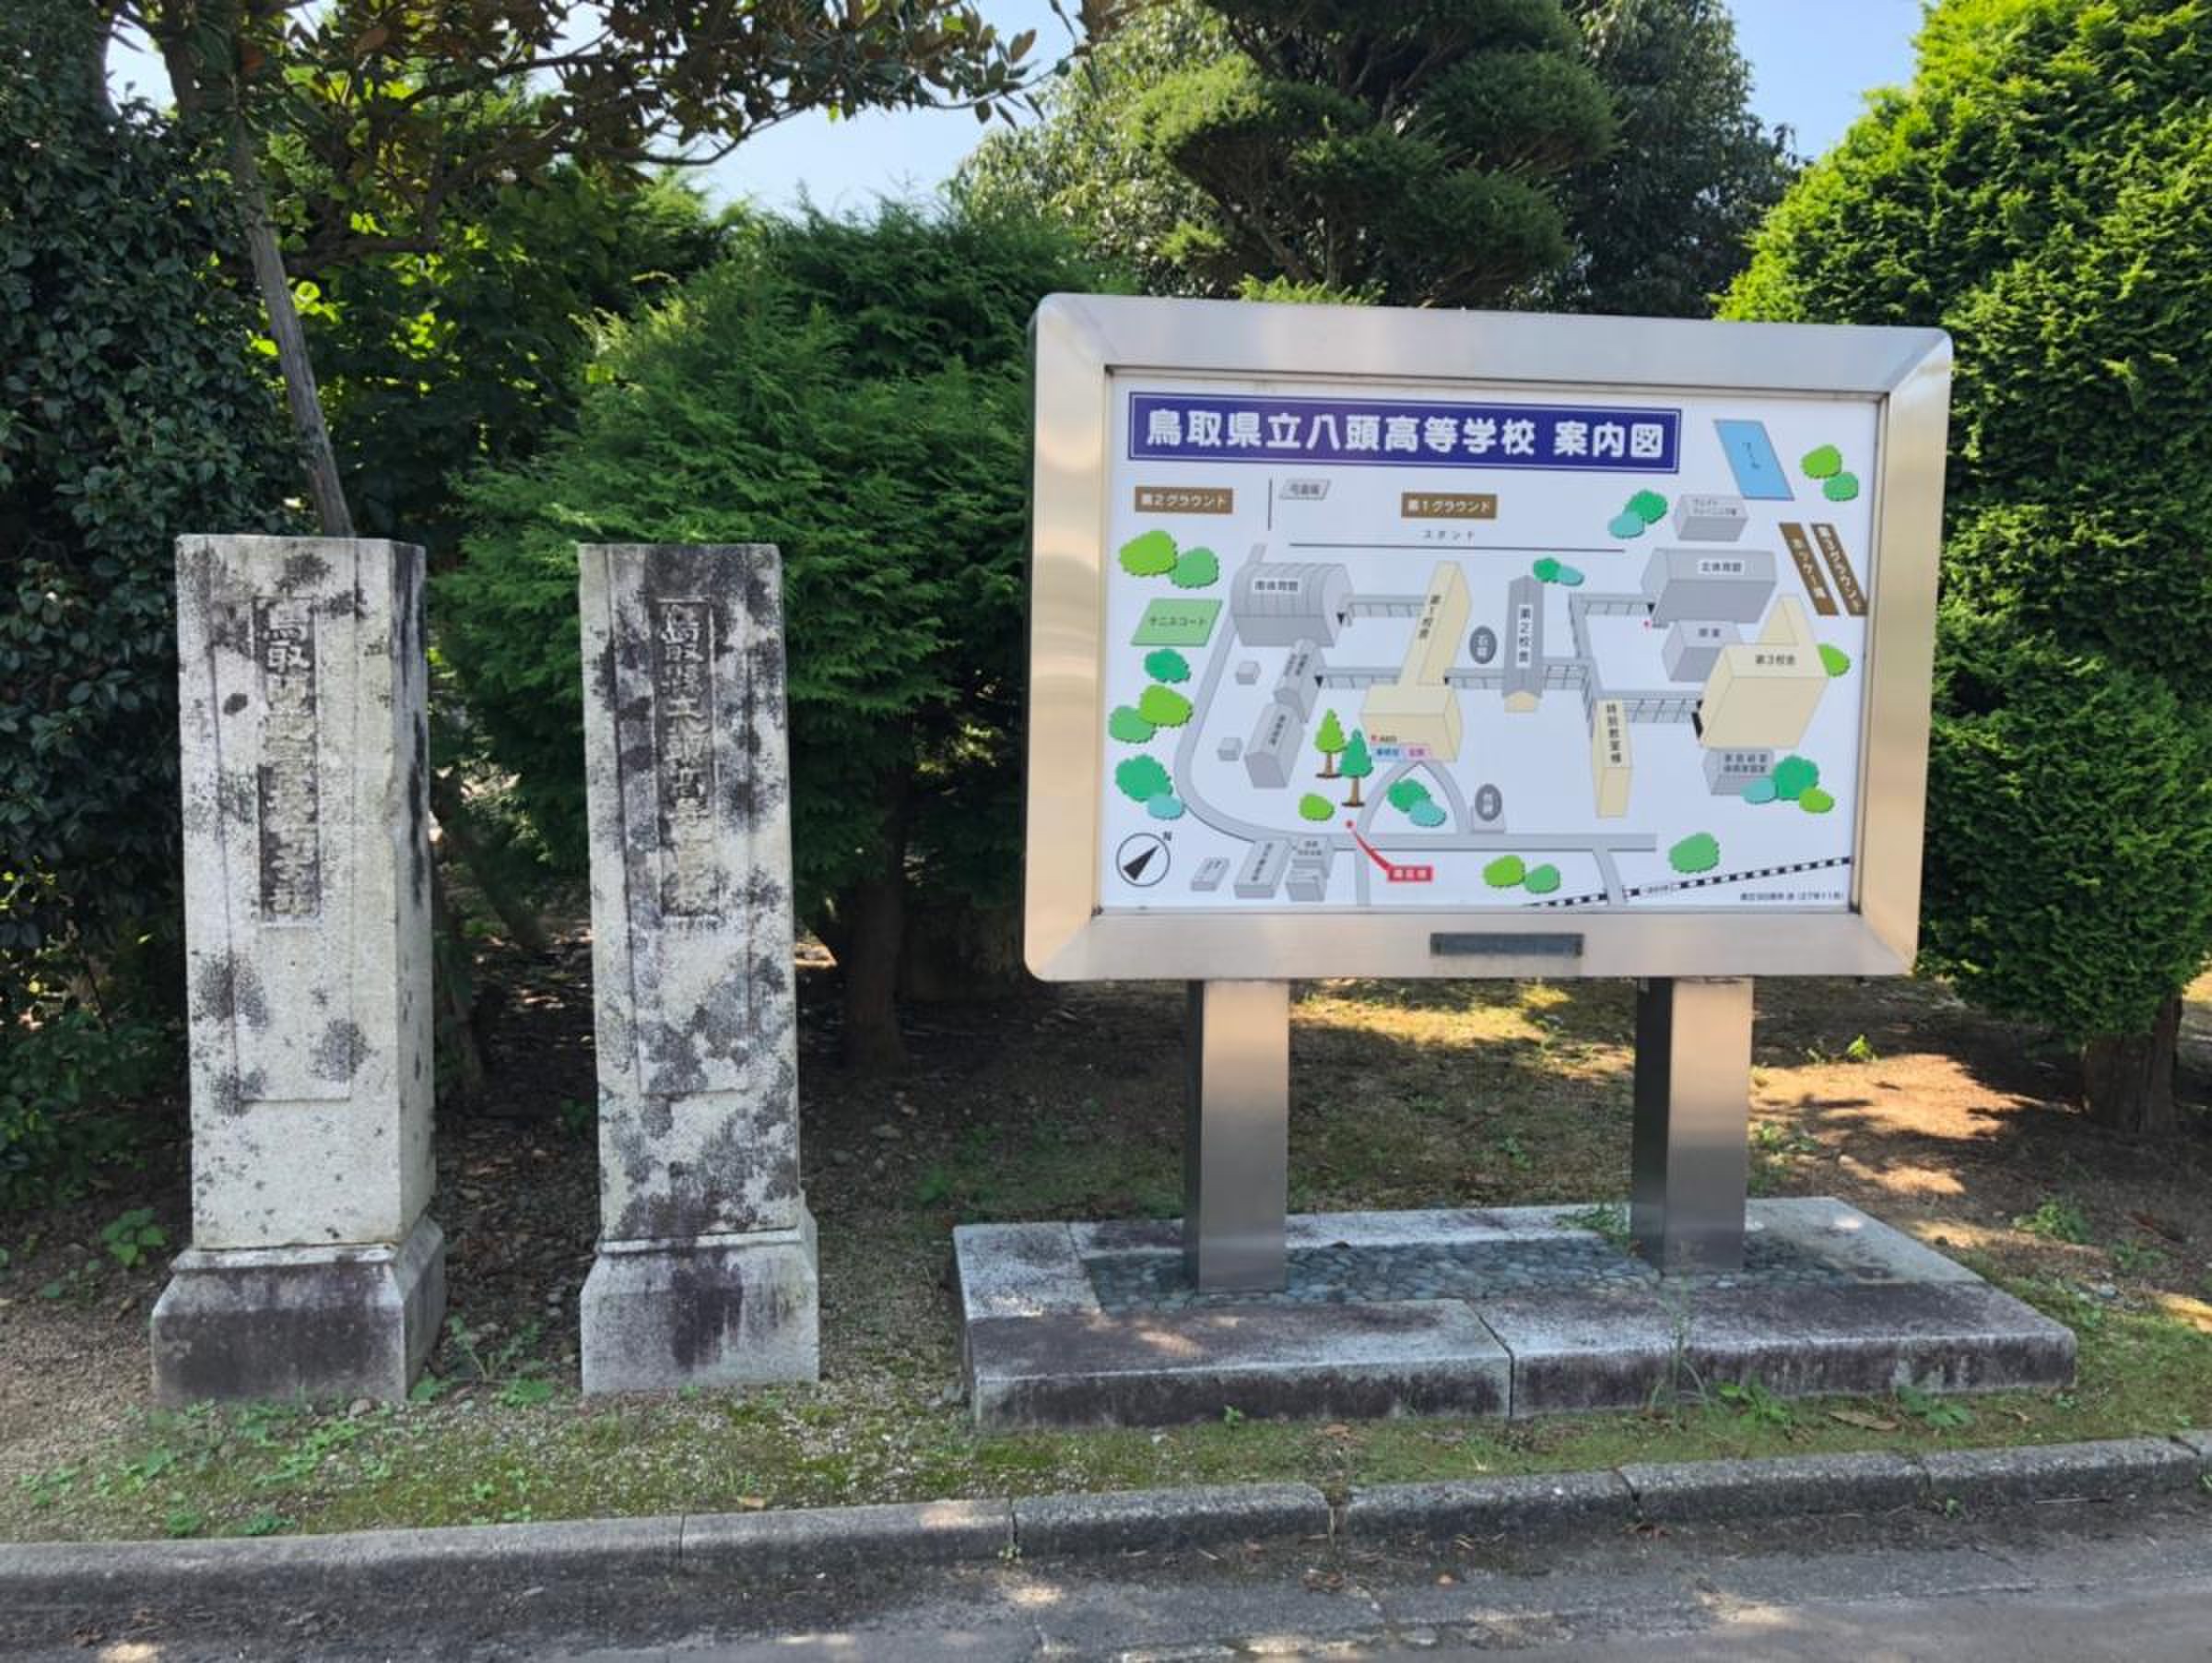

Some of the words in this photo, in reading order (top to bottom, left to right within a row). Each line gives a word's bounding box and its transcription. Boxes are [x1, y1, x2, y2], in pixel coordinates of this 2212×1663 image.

[1147, 408, 1535, 455] 鳥取県立八頭高等学校
[1554, 420, 1665, 459] 案内図
[1140, 493, 1227, 511] 第2グラウンド
[1407, 499, 1491, 514] 第1グラウンド
[1148, 615, 1208, 629] テニスコート
[1162, 831, 1171, 841] N
